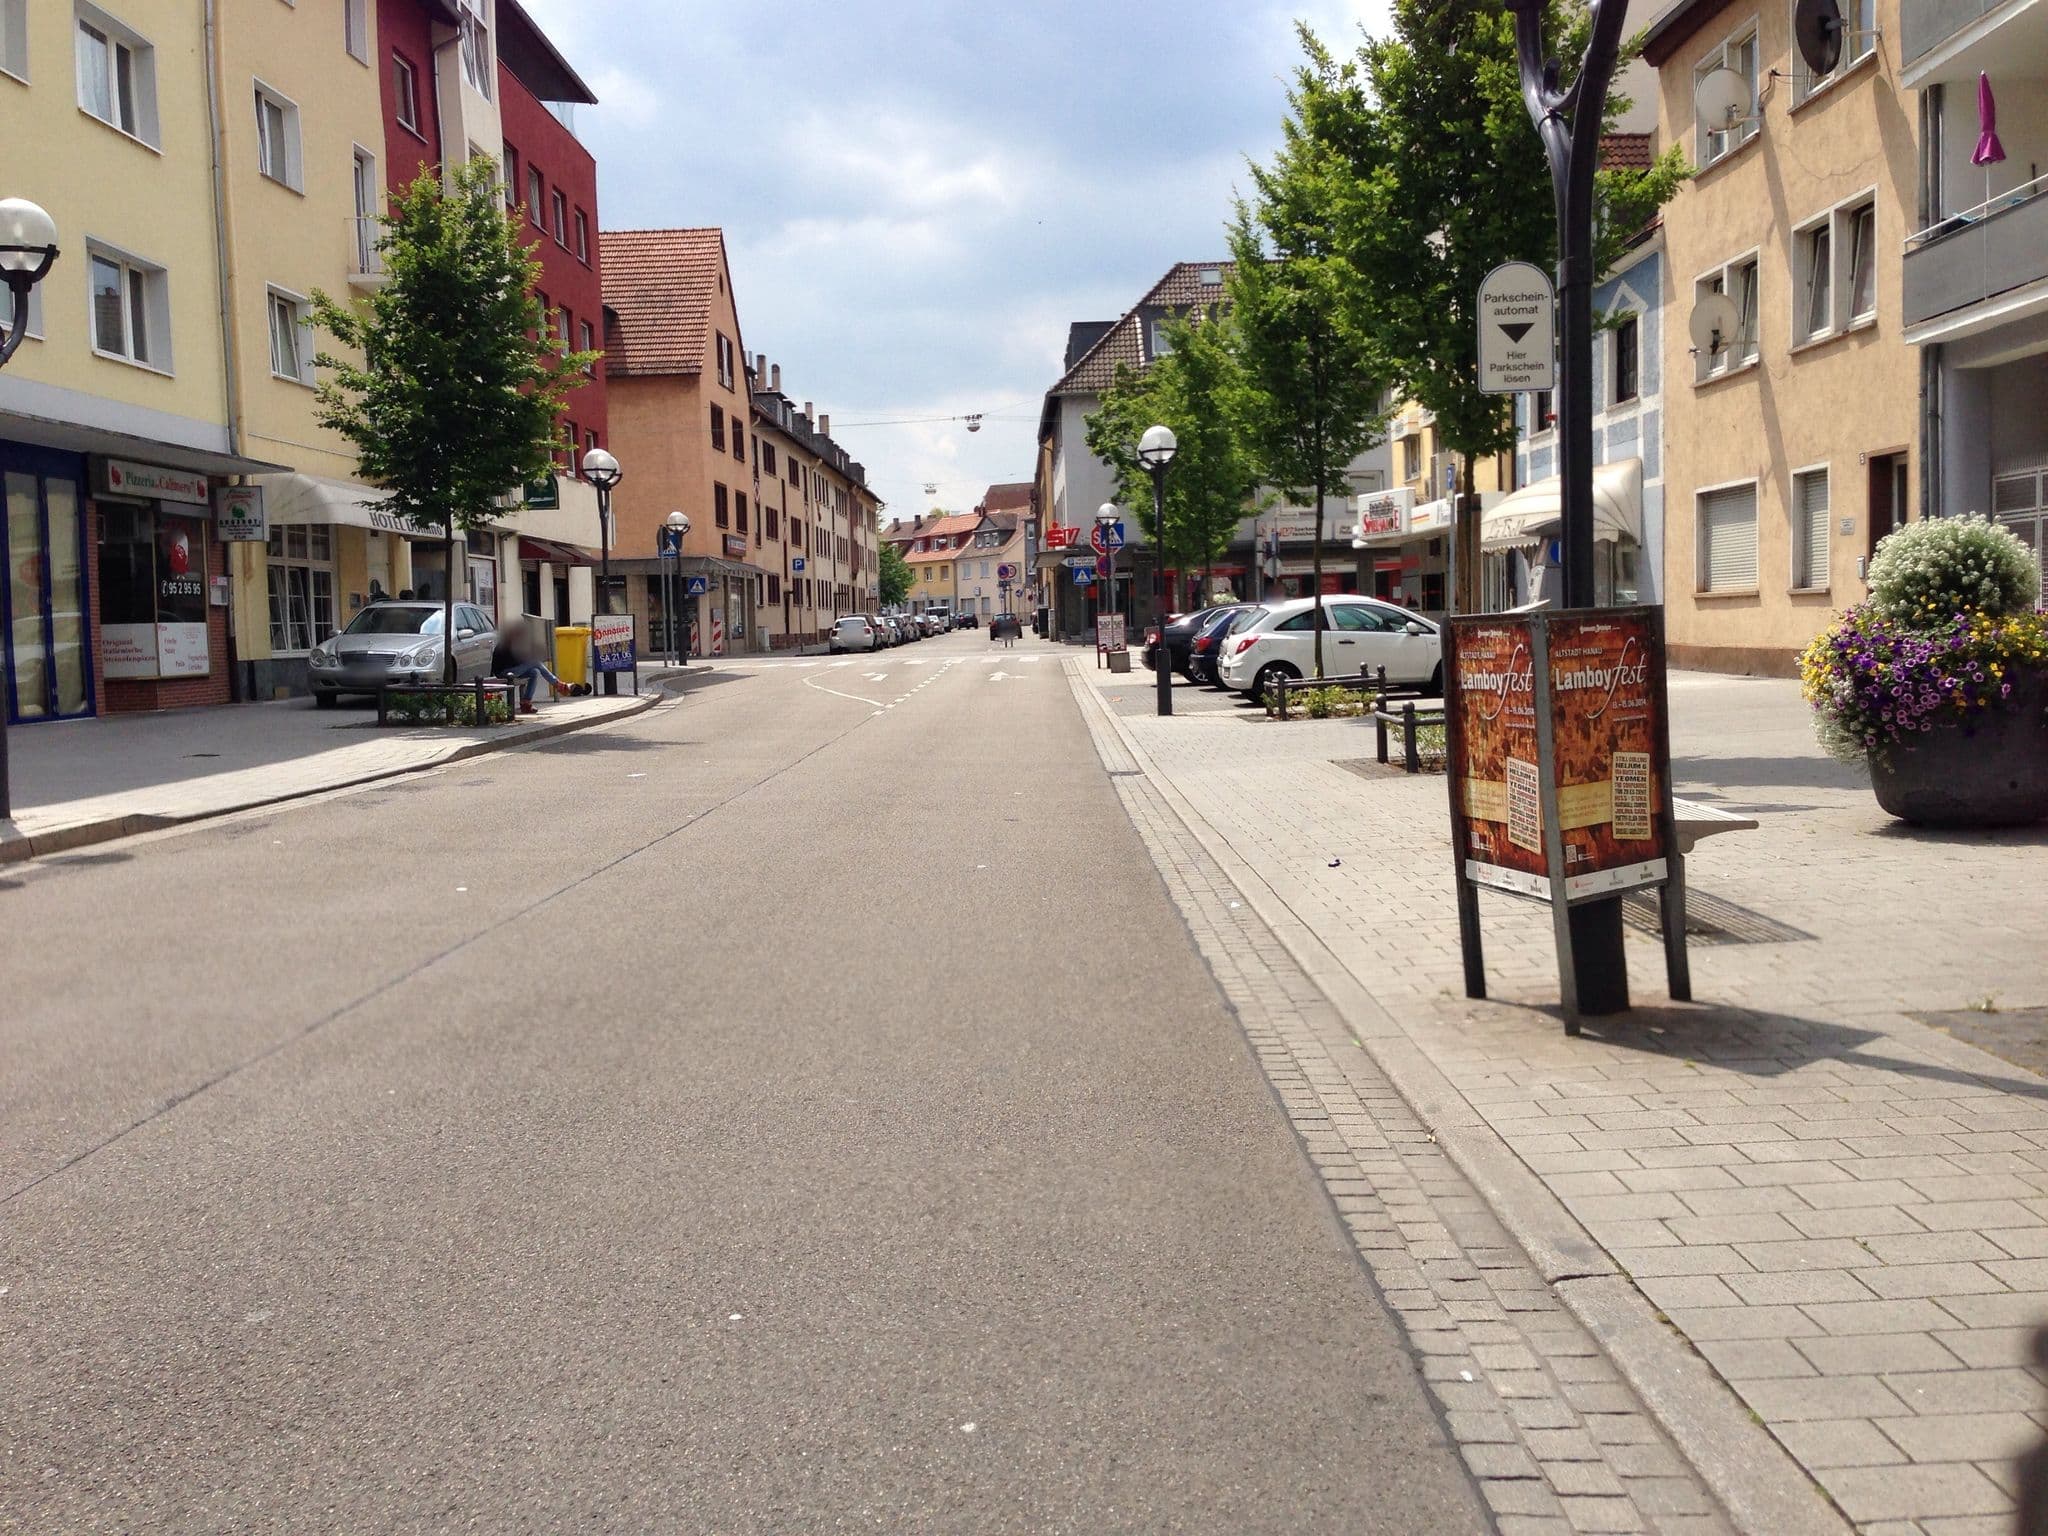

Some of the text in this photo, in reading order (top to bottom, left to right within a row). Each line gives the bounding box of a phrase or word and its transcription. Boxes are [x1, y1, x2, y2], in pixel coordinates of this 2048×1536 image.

[1484, 292, 1548, 303] Parkschein-
[1494, 305, 1538, 316] automat
[1507, 351, 1527, 360] Hier
[1490, 362, 1544, 372] Parkschein
[1504, 374, 1531, 383] lösen
[126, 471, 154, 488] Pizzeria
[369, 512, 407, 531] HOTEL
[795, 559, 803, 569] P
[168, 583, 201, 595] 95 2 95 95
[1460, 643, 1534, 720] Lamboyfest
[1555, 636, 1647, 719] Lamboyfest
